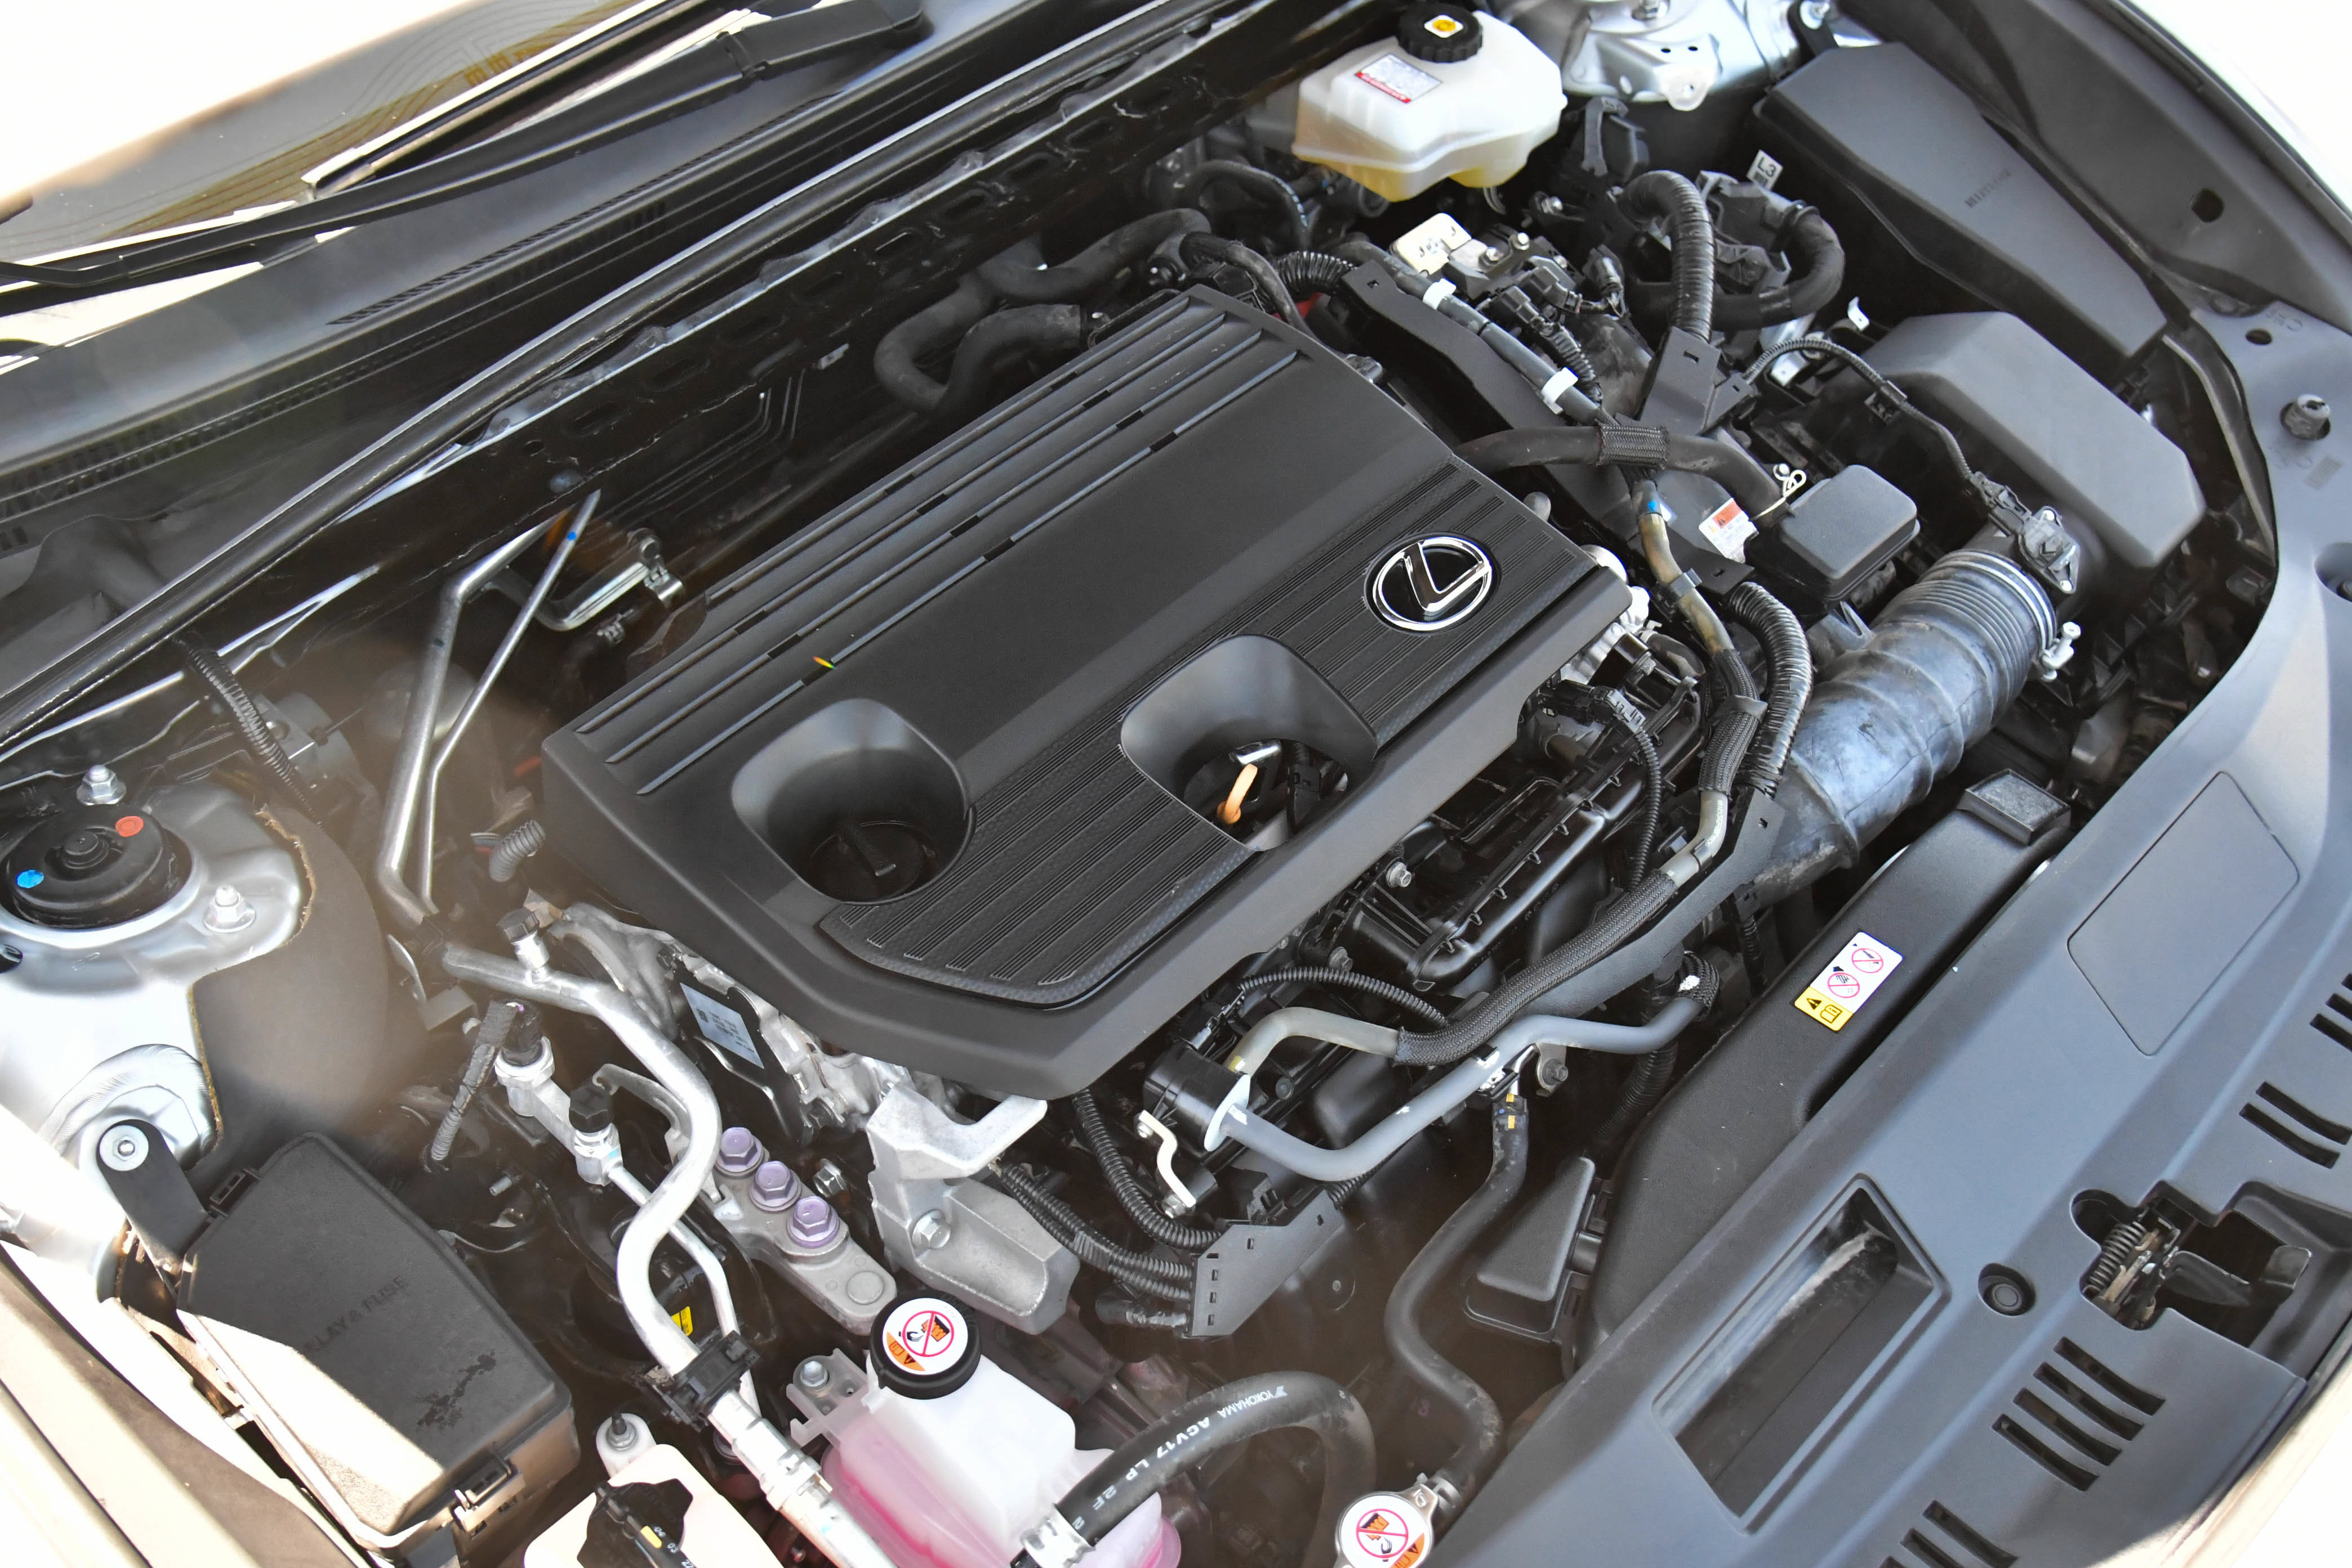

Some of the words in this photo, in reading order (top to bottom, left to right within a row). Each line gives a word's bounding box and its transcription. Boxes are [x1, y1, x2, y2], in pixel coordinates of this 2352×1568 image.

[1758, 157, 1776, 178] L3
[1217, 1390, 1274, 1419] YOKOHAMA
[1157, 1417, 1210, 1459] ACV17
[1126, 1459, 1150, 1481] LP
[1093, 1485, 1117, 1510] 2F
